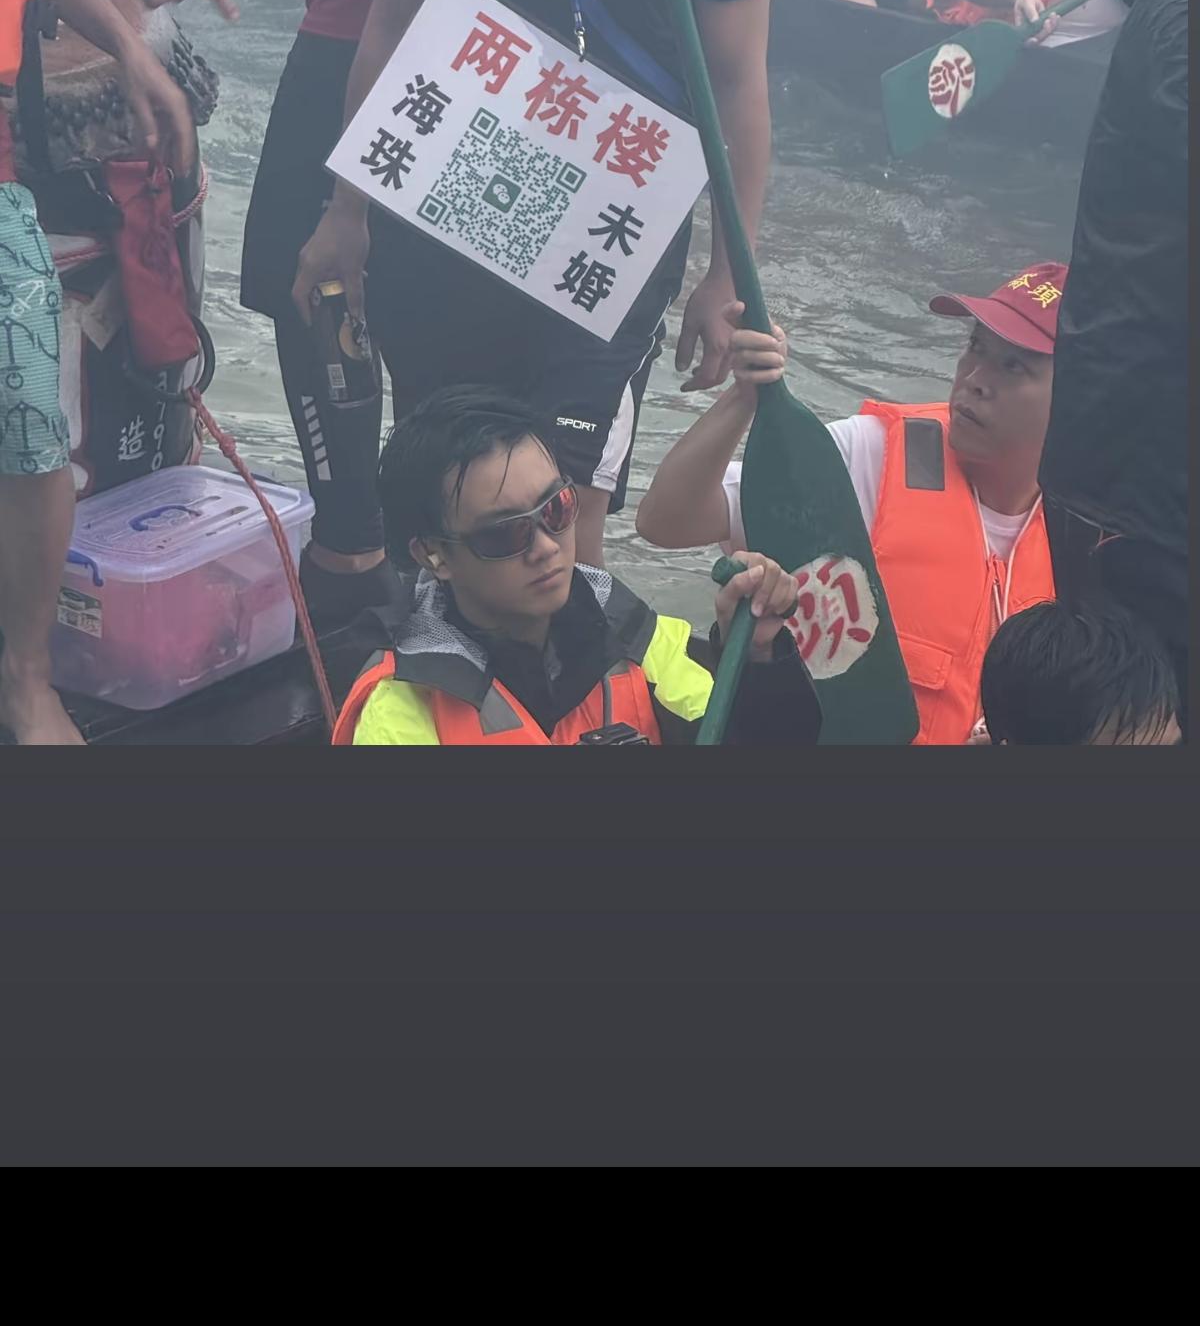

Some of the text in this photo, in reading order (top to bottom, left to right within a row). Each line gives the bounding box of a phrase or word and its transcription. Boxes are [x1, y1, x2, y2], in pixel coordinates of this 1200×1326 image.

[360, 73, 453, 191] 海珠
[449, 10, 671, 189] 两栋楼
[554, 202, 646, 313] 未婚
[118, 414, 146, 461] 造
[556, 416, 597, 433] SPORT
